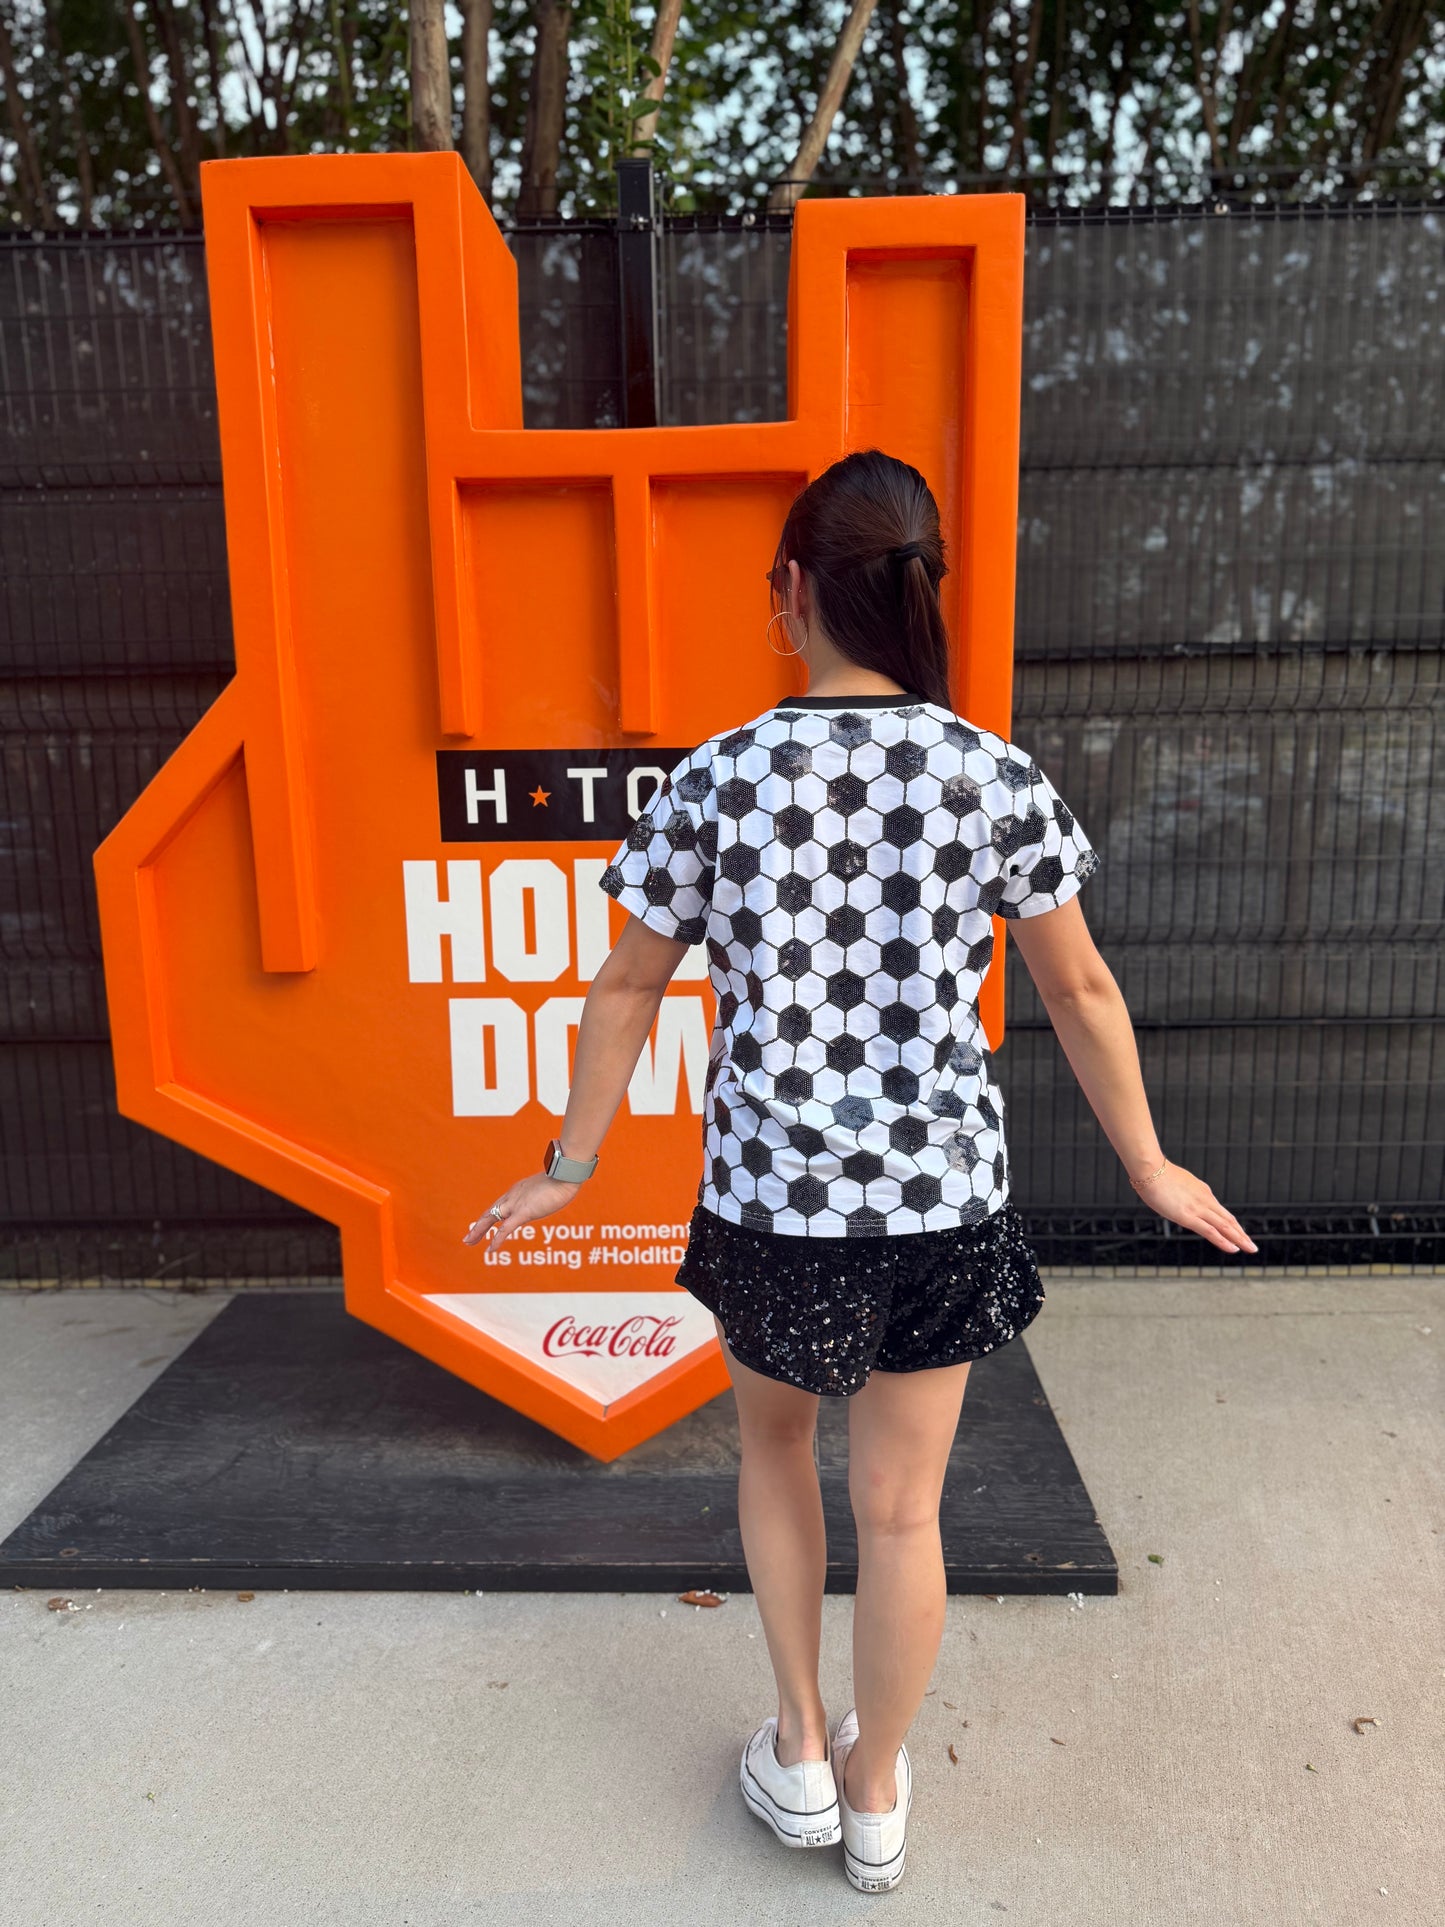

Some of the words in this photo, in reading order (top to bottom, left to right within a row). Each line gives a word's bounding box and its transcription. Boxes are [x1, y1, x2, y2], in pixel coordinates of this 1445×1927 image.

[464, 768, 508, 824] H
[402, 859, 709, 983] HOL
[542, 1224, 594, 1244] your
[484, 1250, 512, 1266] us
[518, 1247, 582, 1270] using
[543, 1315, 685, 1358] Coca-Cola
[804, 1825, 832, 1835] CONVERSE
[806, 1835, 816, 1846] ALL
[821, 1831, 833, 1844] STAR
